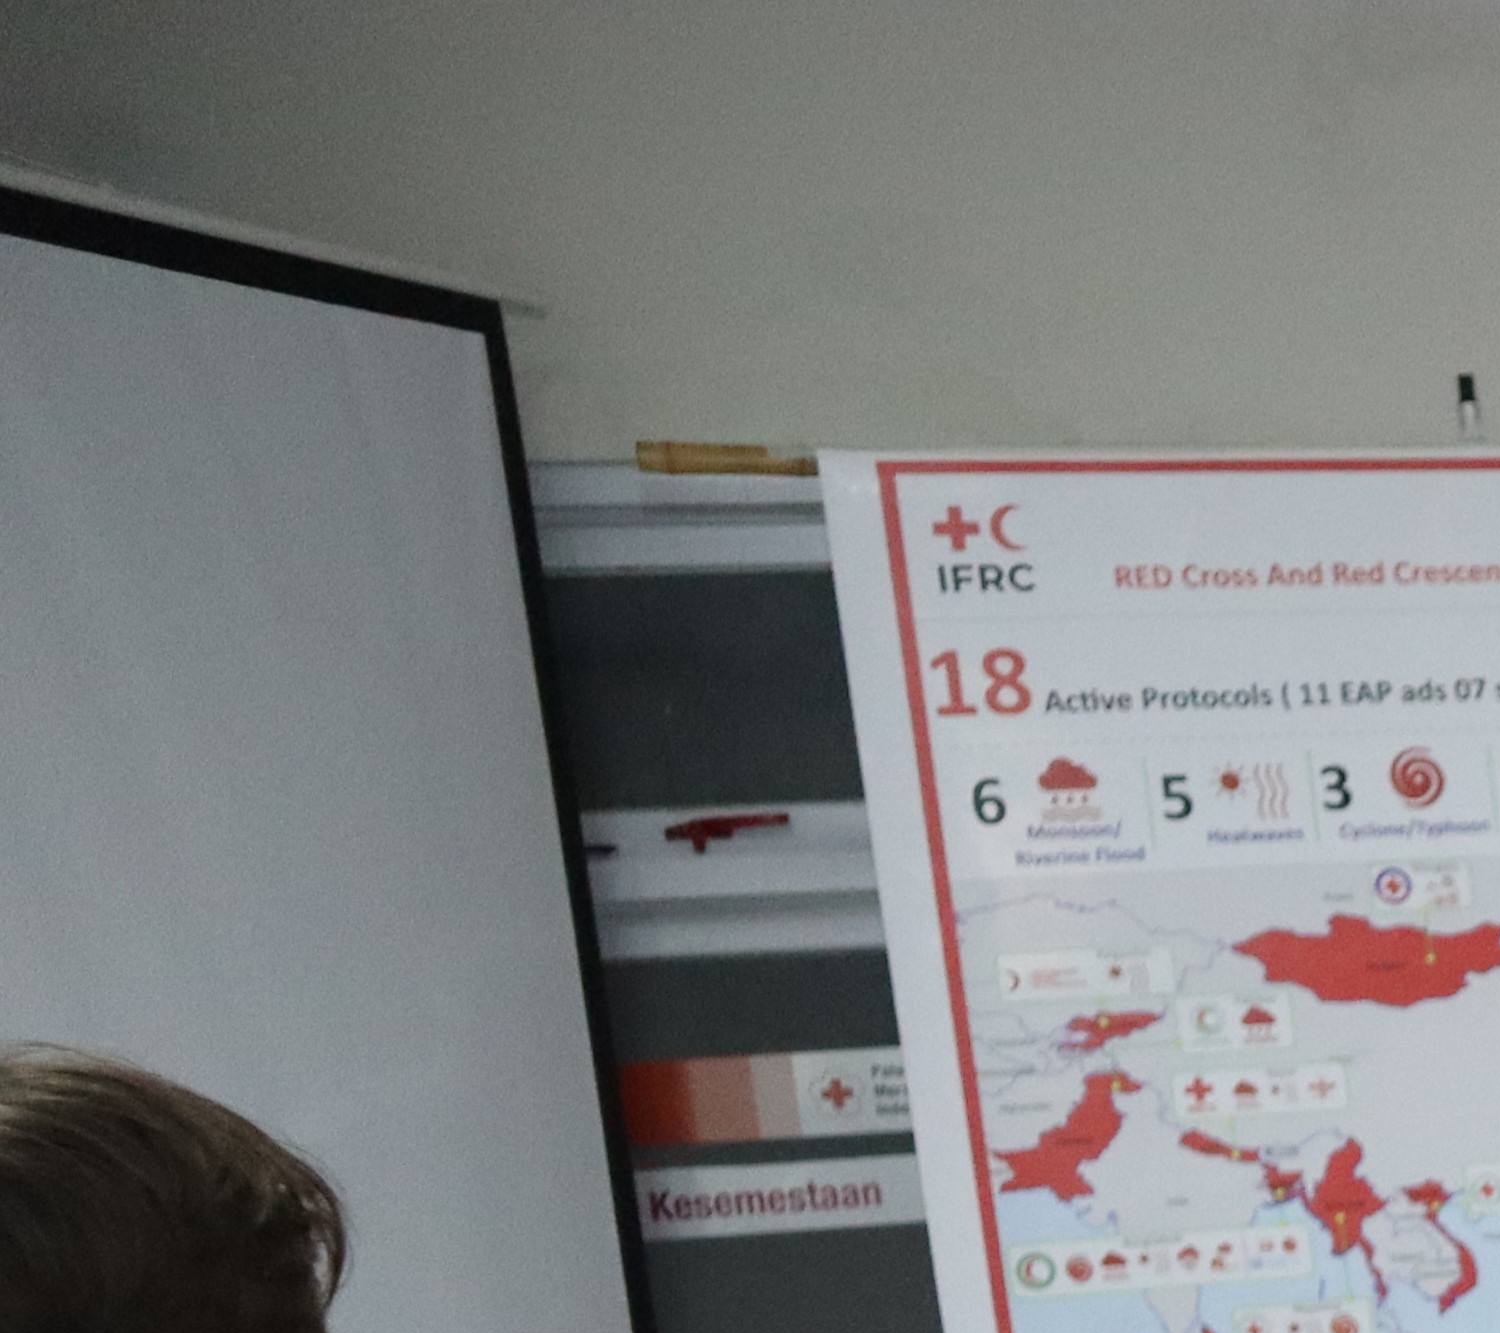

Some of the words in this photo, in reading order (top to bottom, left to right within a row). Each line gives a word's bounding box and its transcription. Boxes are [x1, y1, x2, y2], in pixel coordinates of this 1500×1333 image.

[937, 562, 1037, 594] IFRC
[1114, 565, 1173, 589] RED
[1181, 565, 1260, 589] Cross
[1268, 561, 1325, 586] And
[1332, 560, 1384, 585] Red
[929, 646, 1034, 718] 18
[1044, 686, 1134, 715] Active
[1142, 682, 1274, 712] Protocols
[1301, 680, 1331, 708] 11
[1341, 678, 1392, 706] EAP
[1401, 676, 1448, 703] ads
[1455, 675, 1487, 701] 07
[971, 777, 1007, 826] 6
[1161, 773, 1194, 821] 5
[1320, 764, 1353, 811] 3
[649, 1180, 883, 1223] Kesemestaan
